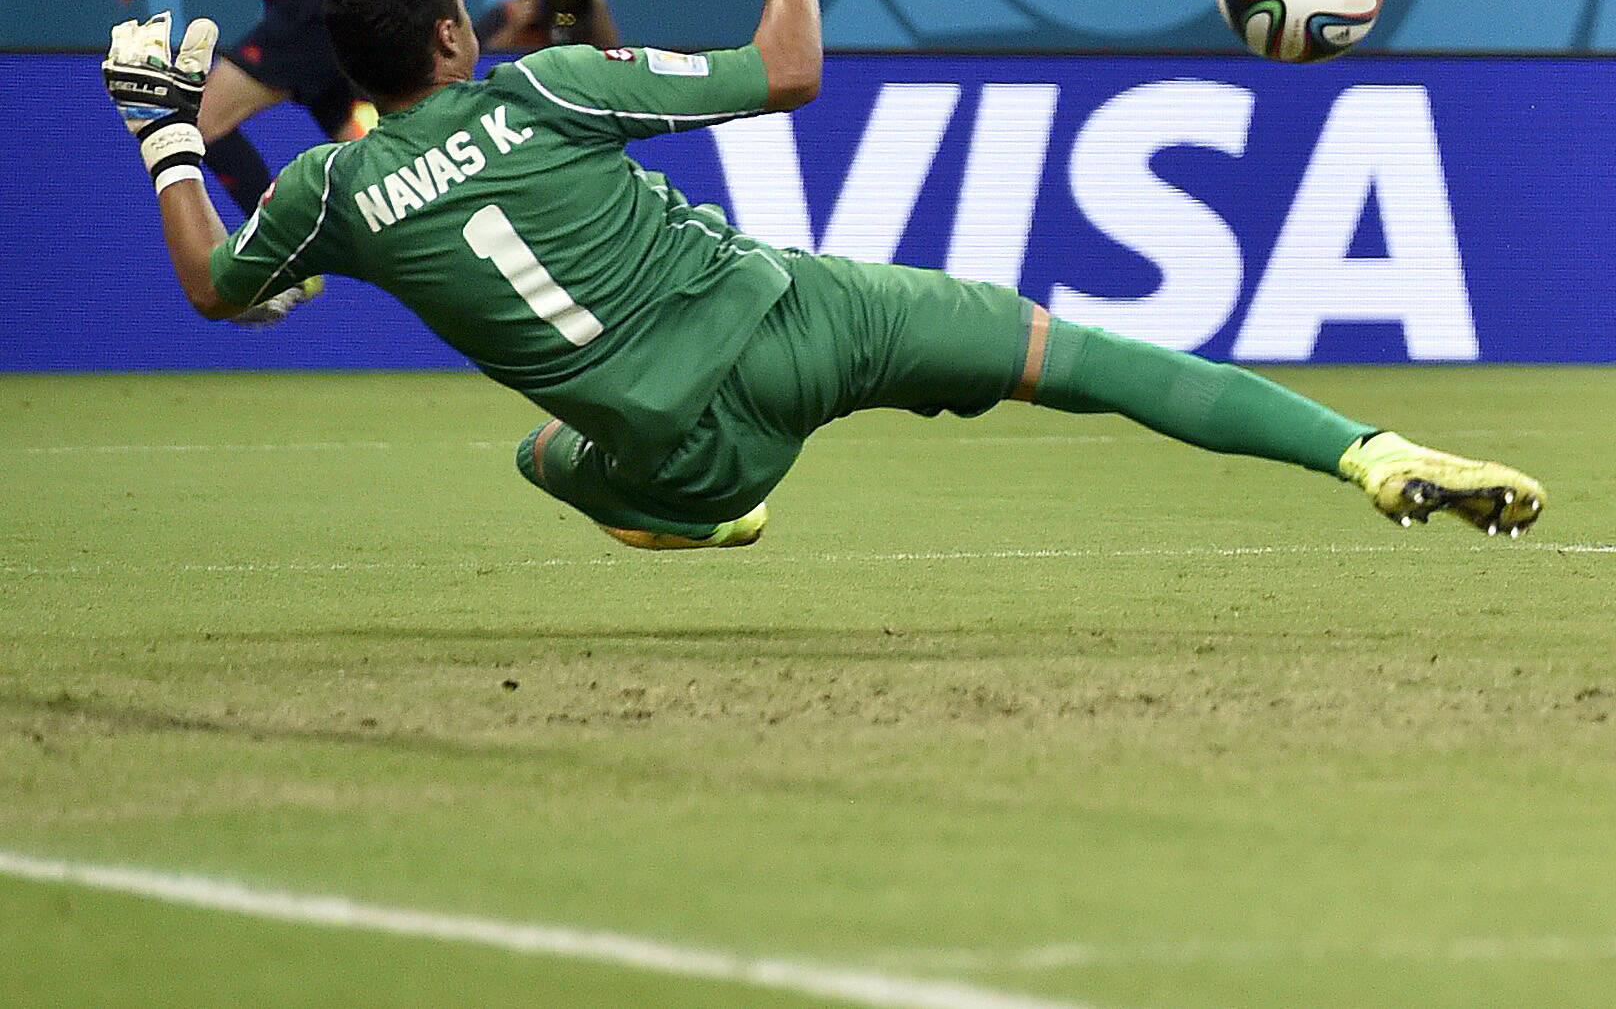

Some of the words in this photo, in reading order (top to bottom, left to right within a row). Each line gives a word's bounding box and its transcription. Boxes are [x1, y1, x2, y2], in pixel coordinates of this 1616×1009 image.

[354, 129, 487, 233] NAVAS
[479, 105, 535, 155] K.
[709, 79, 1479, 360] VISA
[462, 203, 604, 347] 1
